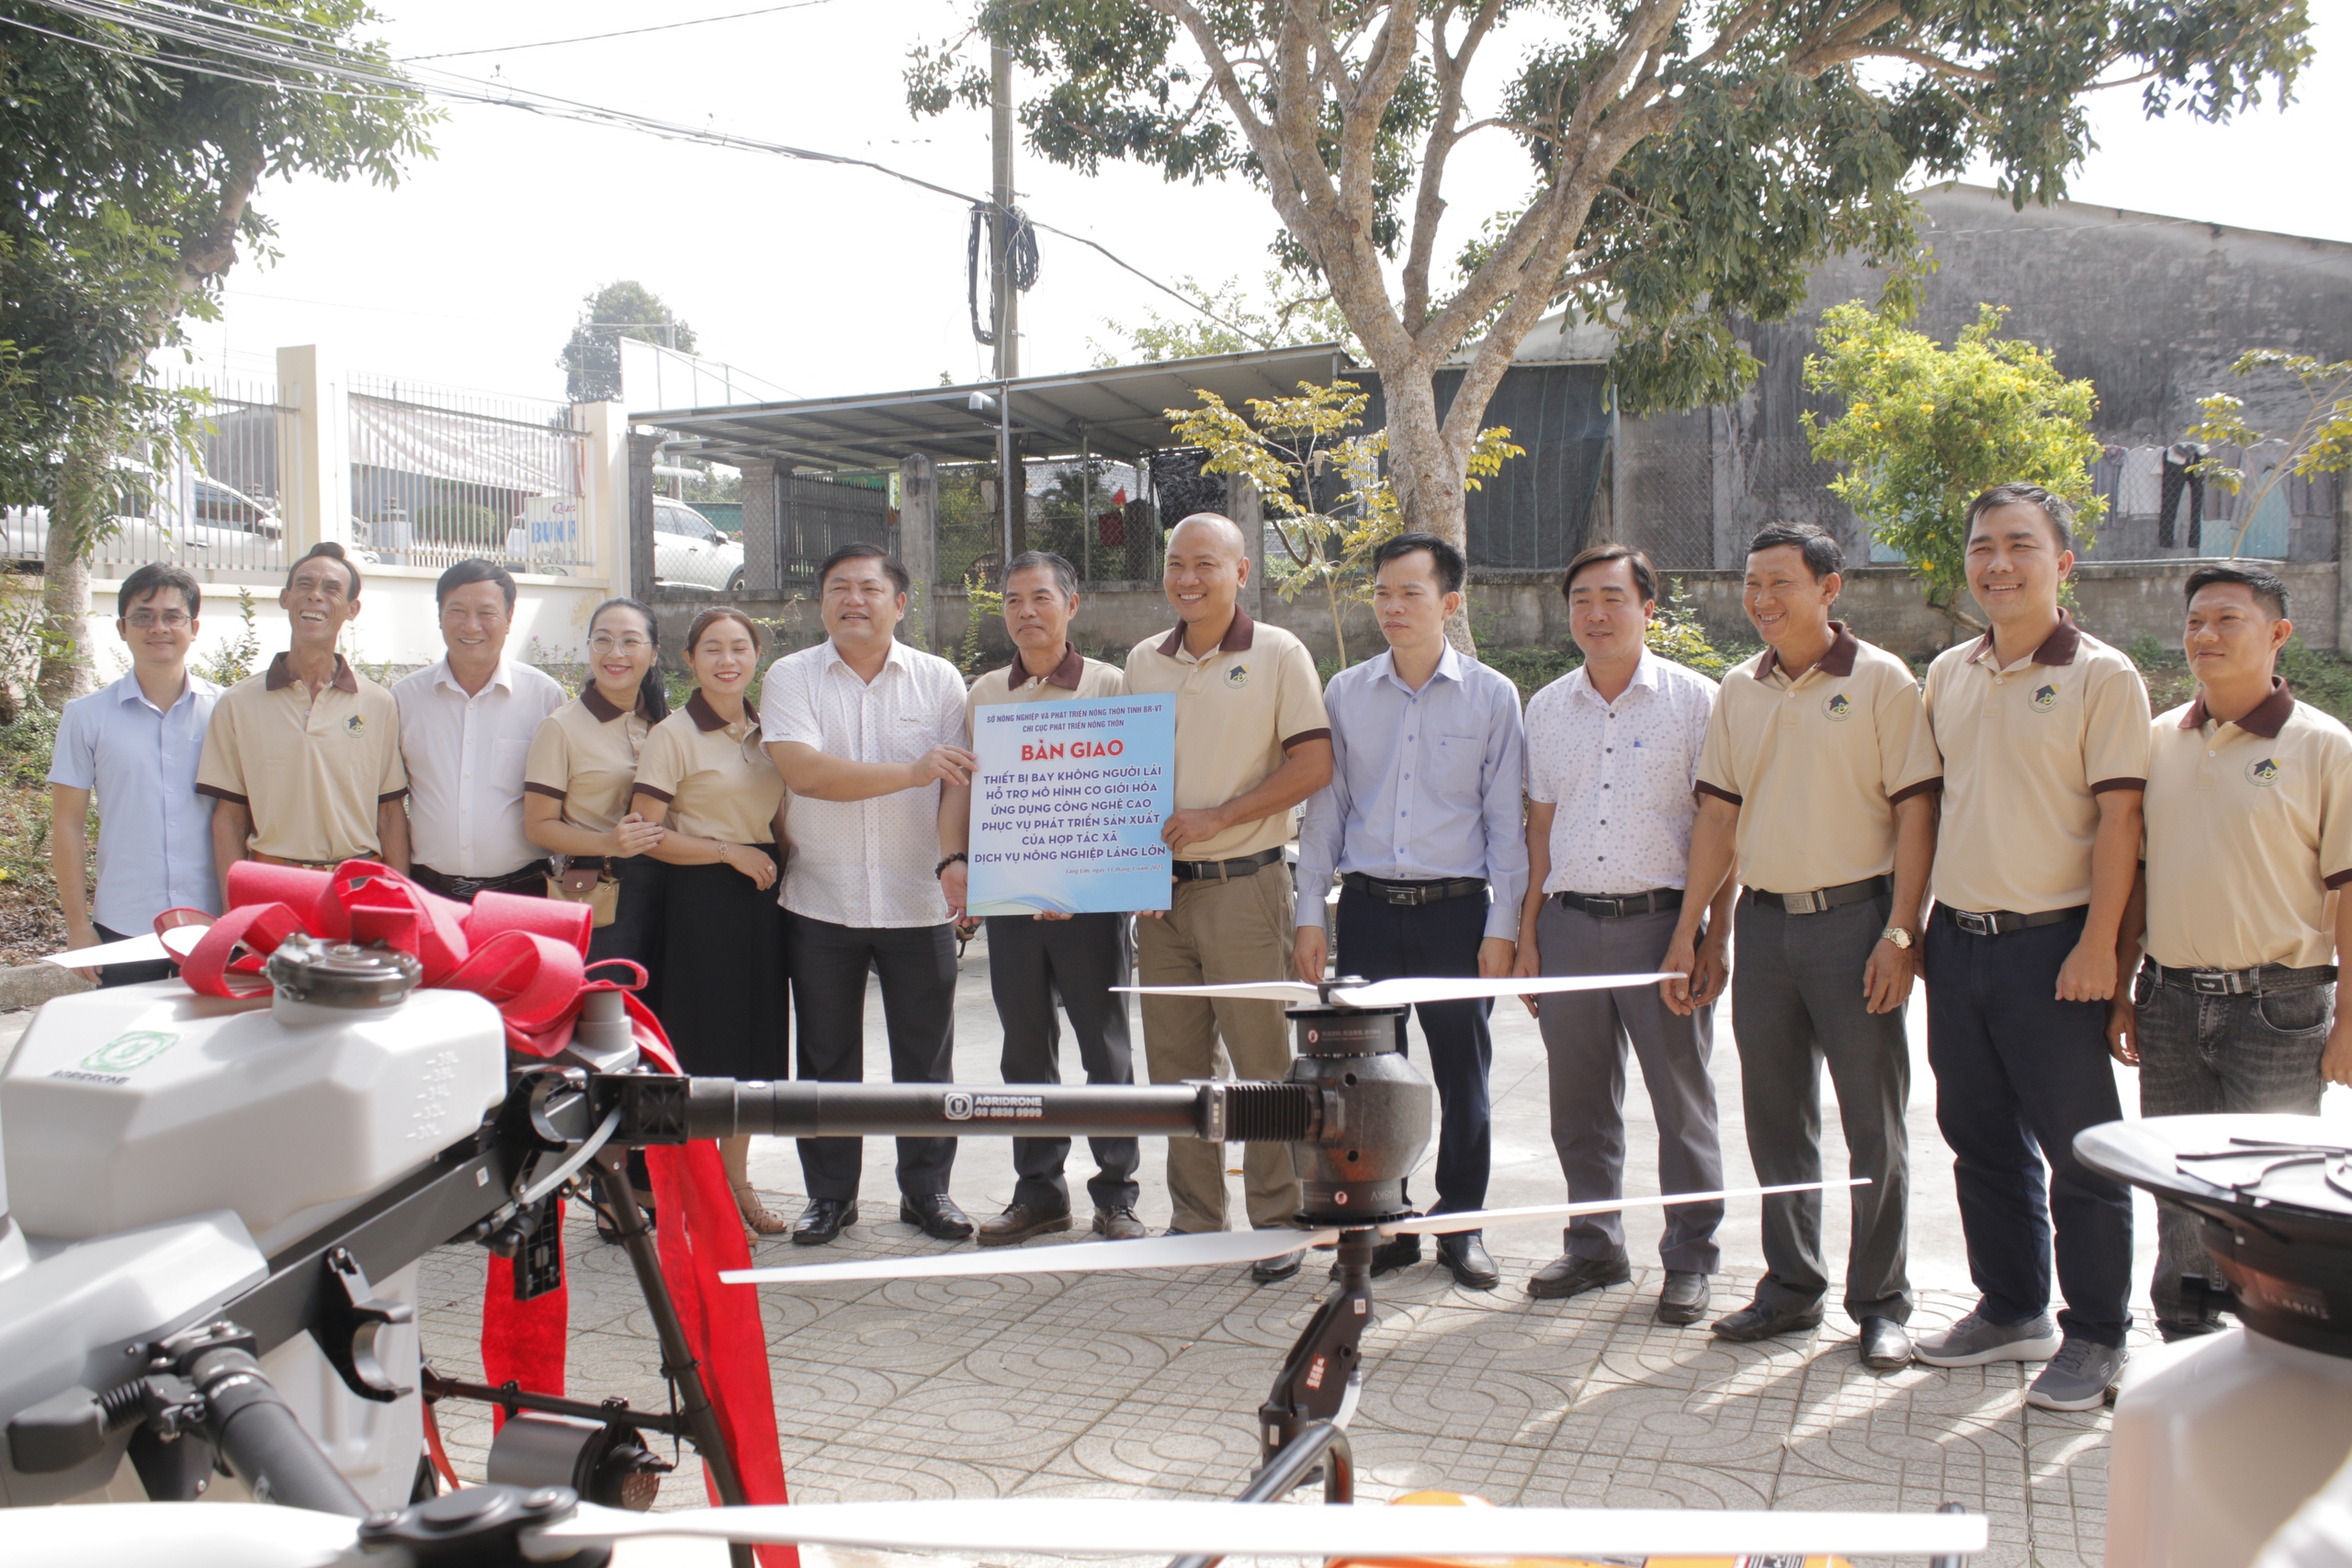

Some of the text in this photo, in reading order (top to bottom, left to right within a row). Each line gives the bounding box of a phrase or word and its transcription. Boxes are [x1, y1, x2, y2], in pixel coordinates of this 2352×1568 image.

[1143, 705, 1162, 713] BR-VT
[1035, 724, 1047, 733] CỤC
[1022, 739, 1124, 761] BÀN GIAO
[984, 764, 1161, 784] THIẾT BỊ BAY KHÔNG NGƯỜI LÁI
[986, 780, 1158, 801] HỖ TRỢ MÔ HÌNH CƠ GIỚI HÓA
[991, 797, 1151, 816] ỨNG DỤNG CÔNG NGHỆ CAO
[982, 810, 1160, 833] PHỤC VỤ PHÁT TRIỂN SẢN XUẤT
[1022, 829, 1117, 846] CỦA HỢP TÁC XÃ
[975, 844, 1165, 864] DỊCH VỤ NÔNG NGHIỆP LÁNG LỚN
[975, 1096, 1043, 1106] AGRIDRONE
